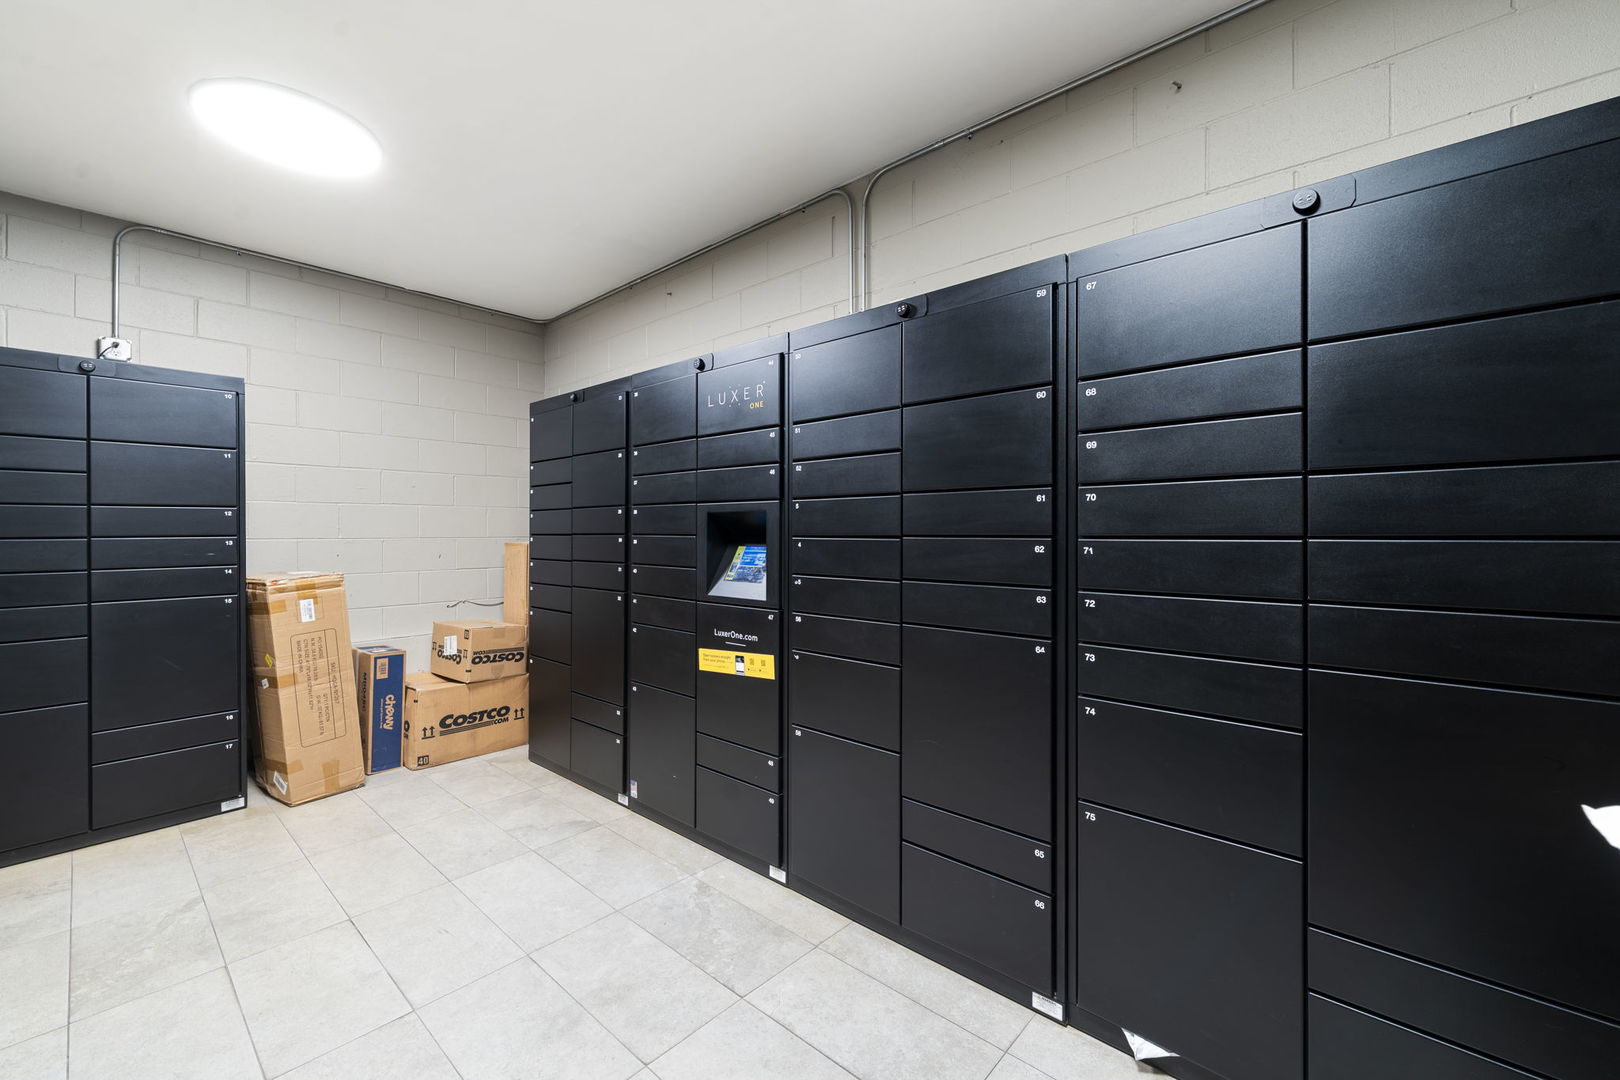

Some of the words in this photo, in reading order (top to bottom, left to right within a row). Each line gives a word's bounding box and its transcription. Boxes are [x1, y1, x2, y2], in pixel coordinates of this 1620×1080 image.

[1086, 281, 1097, 290] 67
[1036, 289, 1046, 298] 59
[707, 384, 764, 407] LUXER
[1036, 391, 1046, 399] 60
[1085, 388, 1096, 396] 68
[749, 401, 764, 409] ONE
[1086, 440, 1097, 449] 69
[1036, 494, 1045, 502] 61
[1085, 493, 1096, 501] 70
[1034, 545, 1045, 553] 62
[1036, 596, 1046, 604] 63
[1084, 599, 1095, 607] 72
[714, 628, 759, 642] LuxerOne.com
[471, 652, 525, 665] COSTCO
[1084, 653, 1095, 662] 73
[383, 694, 396, 730] chewy
[1084, 707, 1096, 715] 74
[439, 705, 510, 729] COSTCO
[1084, 811, 1096, 821] 75
[1034, 849, 1044, 858] 65
[1034, 899, 1044, 910] 66
